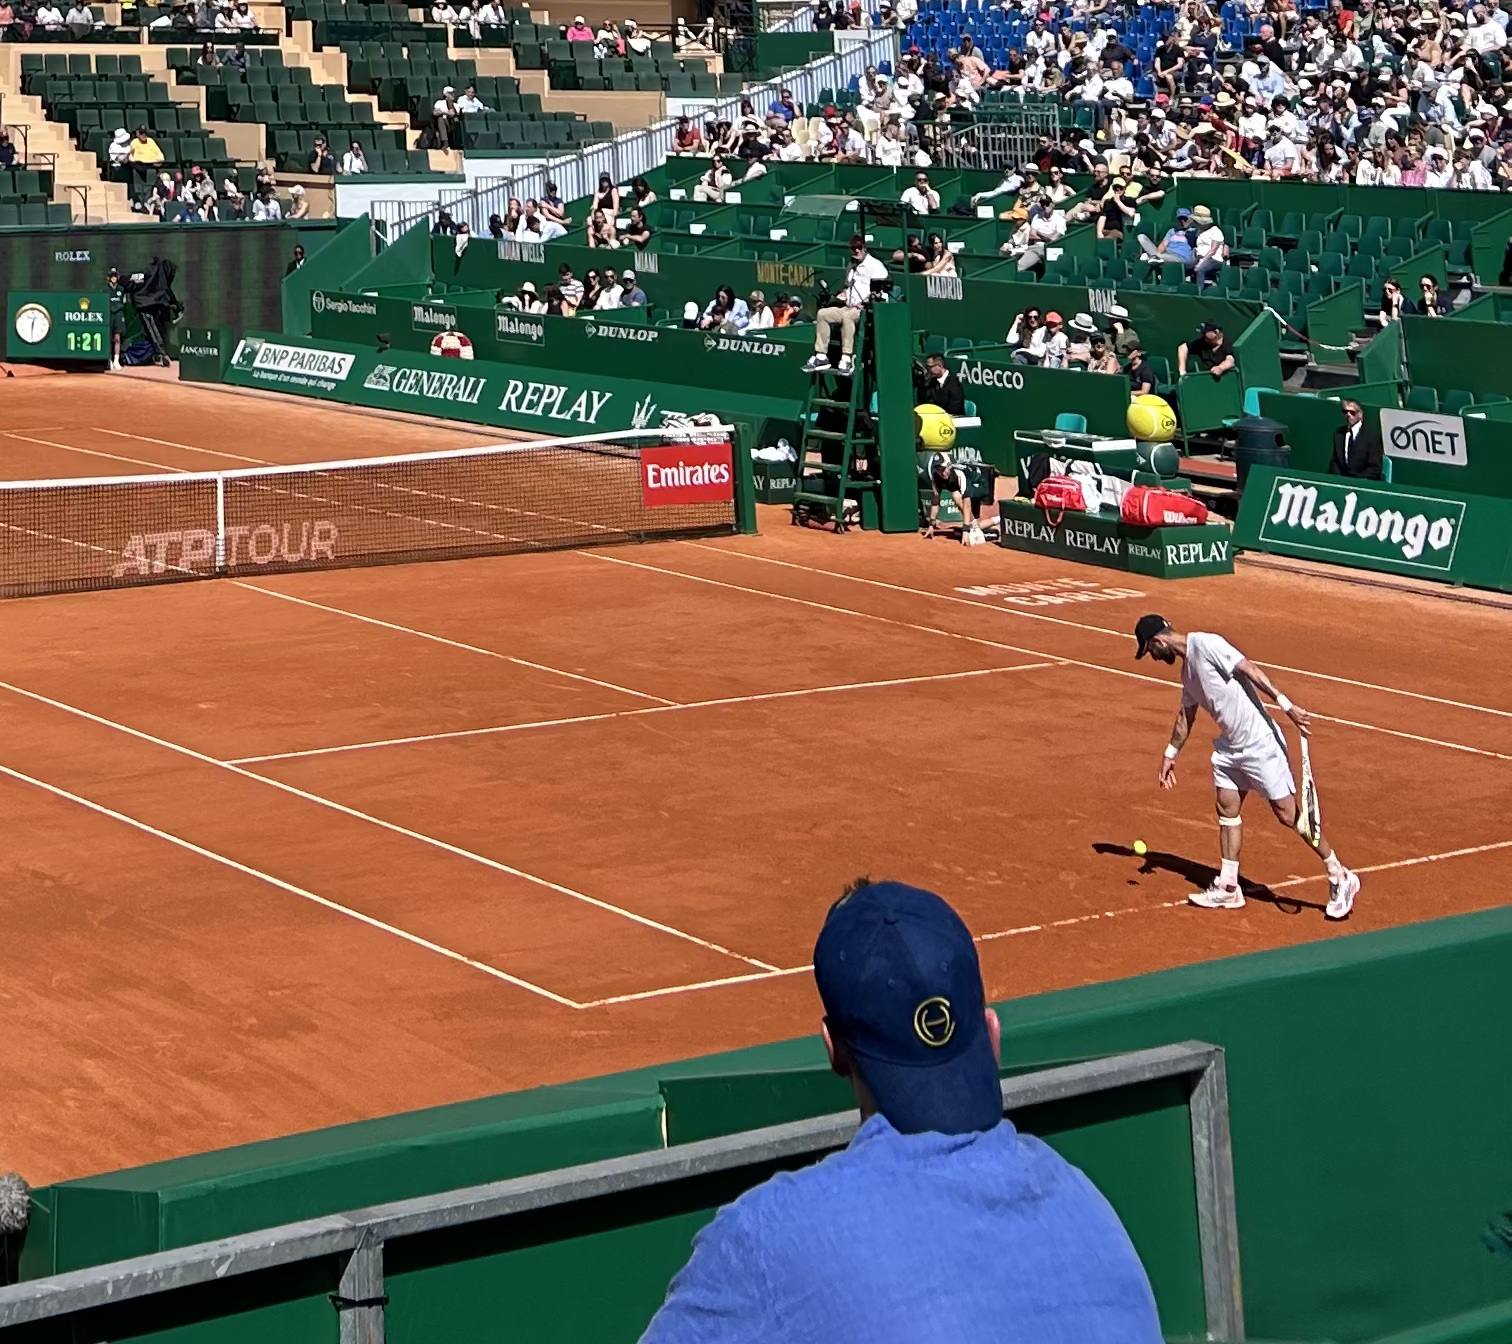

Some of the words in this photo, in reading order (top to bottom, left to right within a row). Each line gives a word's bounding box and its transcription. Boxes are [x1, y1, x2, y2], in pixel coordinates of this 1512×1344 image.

[54, 250, 91, 262] ROLEX
[634, 251, 659, 274] MIAMI
[926, 275, 963, 301] MADRID
[1088, 288, 1117, 313] ROME
[64, 311, 104, 323] ROLEX
[325, 297, 348, 313] Sergio
[347, 300, 377, 316] Tacchini
[413, 305, 457, 330] Malongo
[497, 315, 544, 340] Malongo
[598, 325, 659, 343] DUNLOP
[67, 331, 102, 352] 1:21
[717, 338, 786, 357] DUNLOP
[259, 347, 289, 367] BNP
[288, 350, 347, 375] PARIBAS
[392, 367, 487, 405] GENERALI
[957, 361, 1024, 390] Adecco
[498, 379, 613, 424] REPLAY
[645, 461, 730, 489] Emirates
[769, 476, 797, 490] REPLA
[1003, 517, 1056, 543] REPLAY
[1271, 482, 1453, 560] Malongo
[110, 528, 217, 579] ATP
[222, 520, 339, 567] TOUR
[1065, 528, 1122, 555] REPLAY
[1128, 543, 1162, 561] REPLAY
[1166, 540, 1229, 565] REPLAY
[952, 577, 1101, 597] MONTE
[1004, 587, 1148, 606] CARLO
